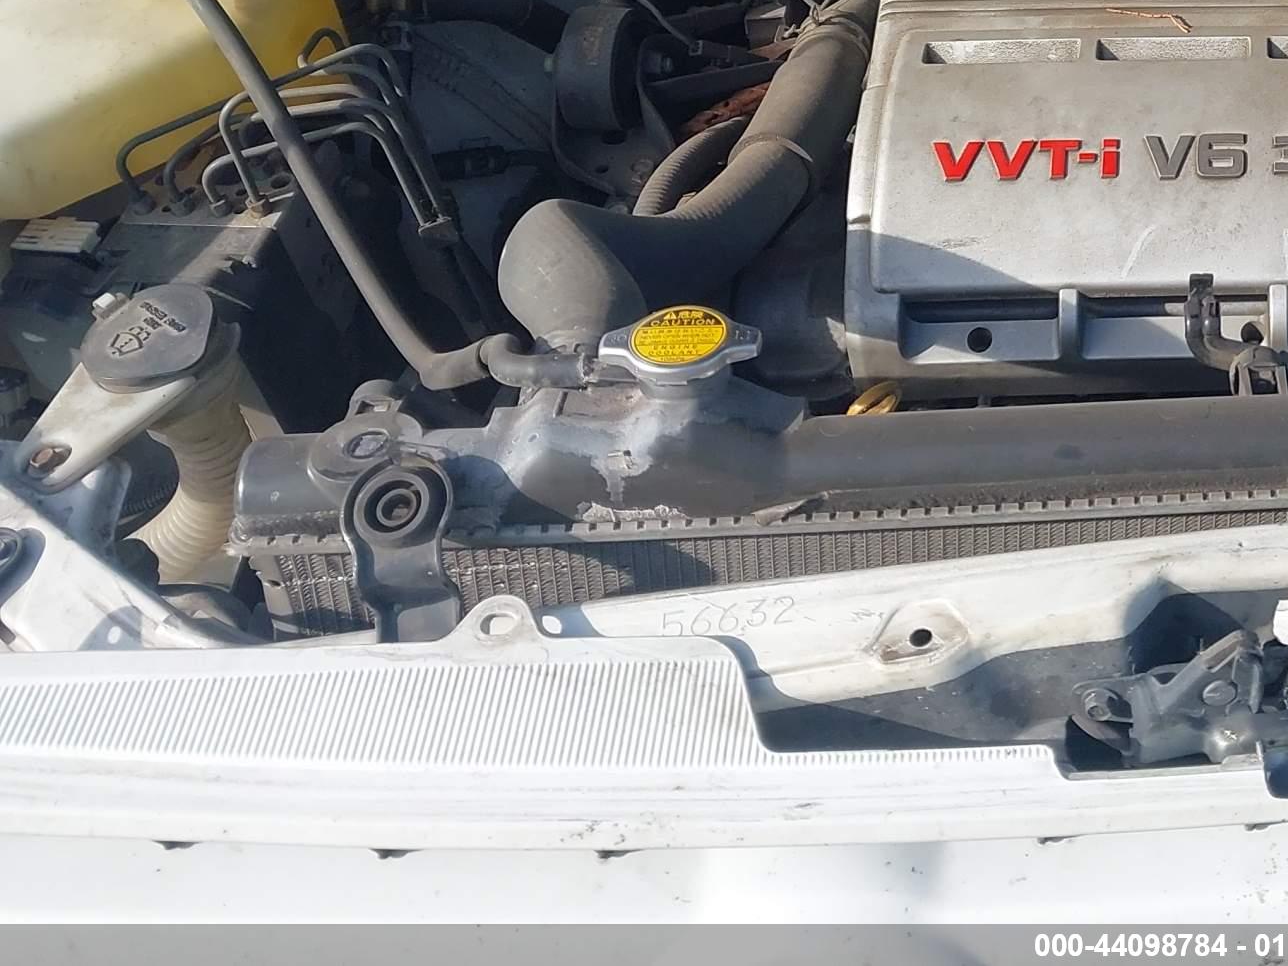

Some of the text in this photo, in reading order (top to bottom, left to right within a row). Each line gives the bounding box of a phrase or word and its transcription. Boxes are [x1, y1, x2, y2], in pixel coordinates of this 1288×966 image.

[933, 138, 1122, 182] VVT-i
[1143, 132, 1247, 181] V6
[650, 319, 716, 327] CAUTION
